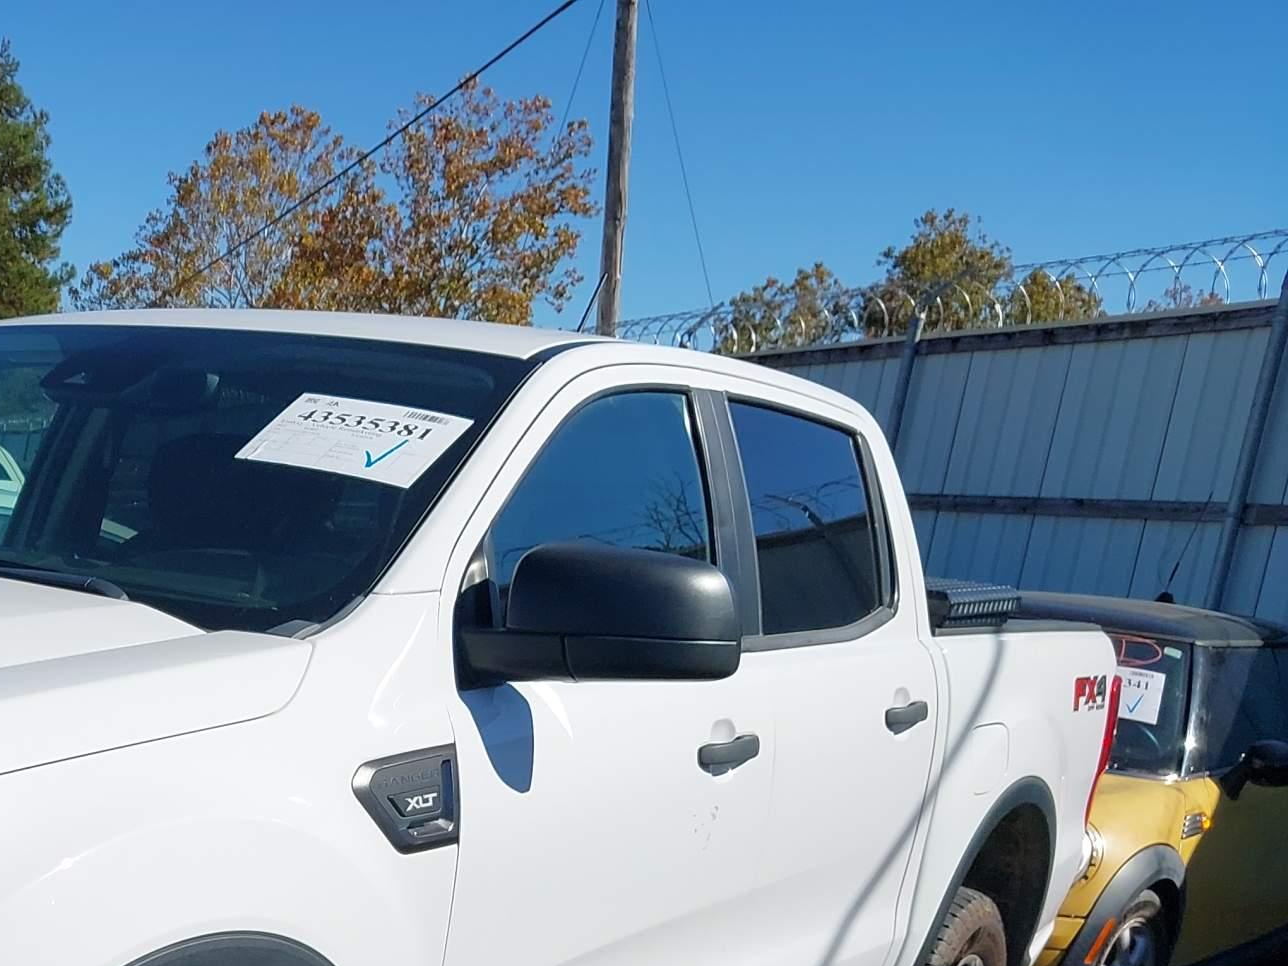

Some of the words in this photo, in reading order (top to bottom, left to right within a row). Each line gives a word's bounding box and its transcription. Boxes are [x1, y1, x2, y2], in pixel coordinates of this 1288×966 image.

[297, 409, 433, 441] 43535381
[1073, 675, 1107, 712] FX4
[404, 792, 438, 812] XLT
